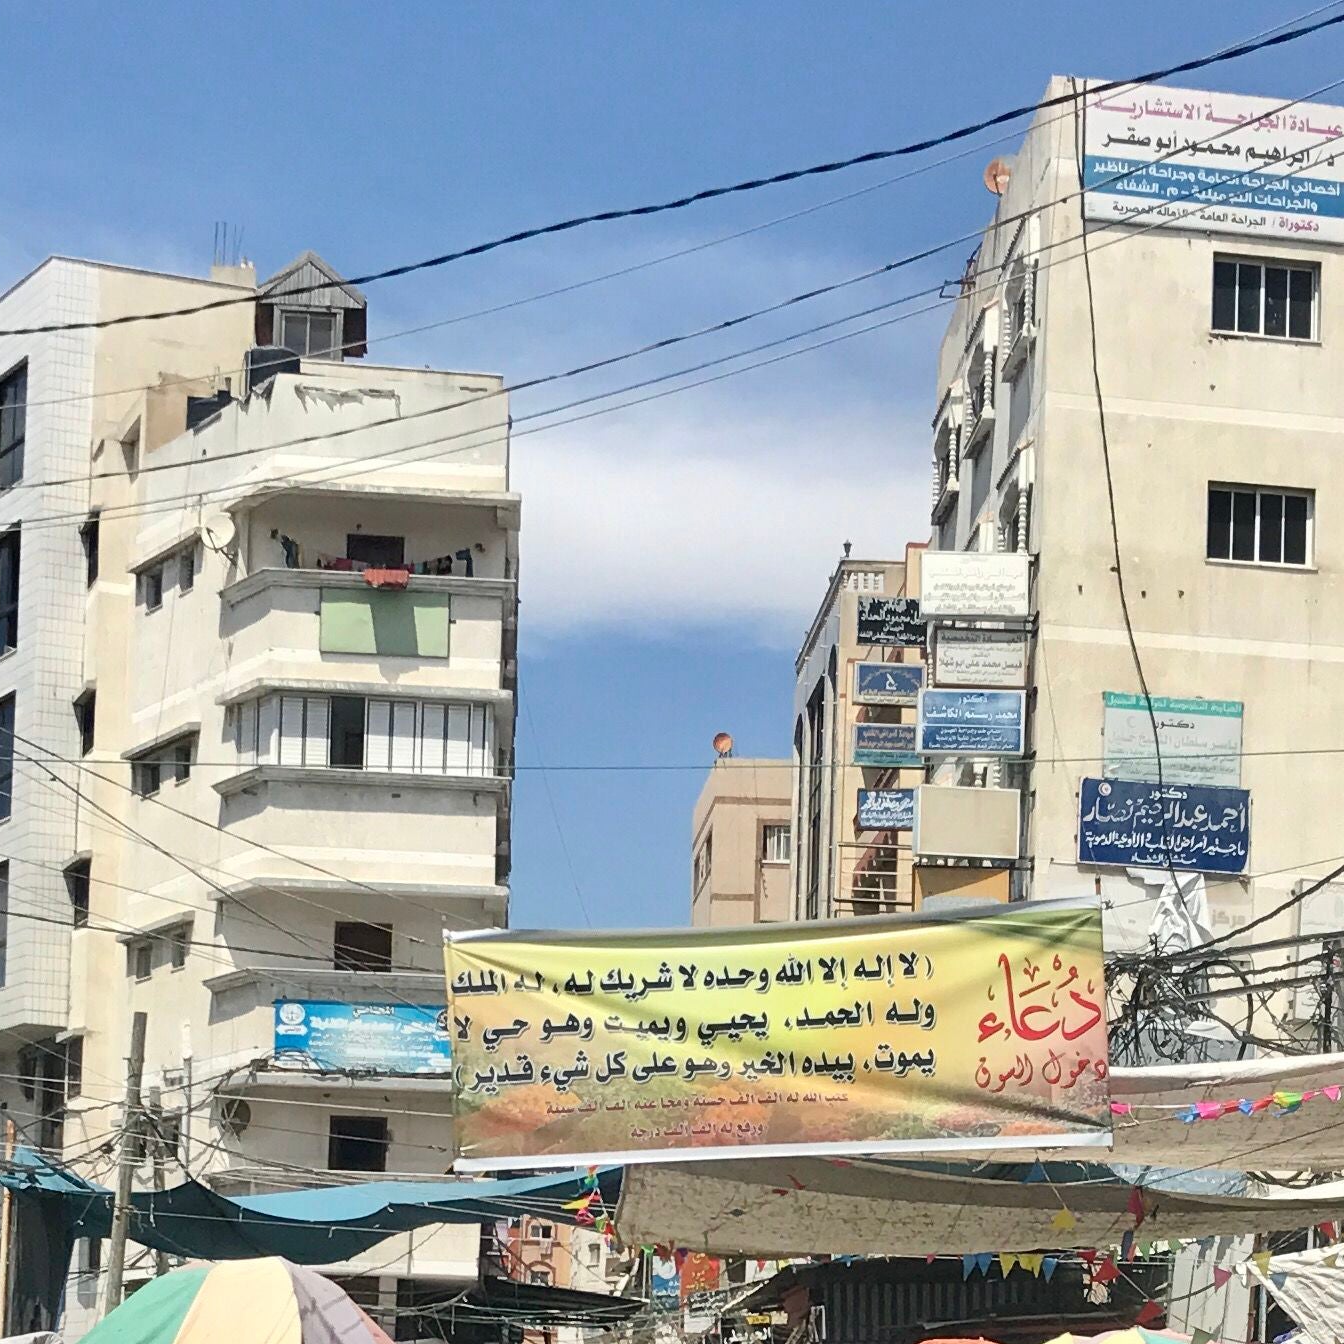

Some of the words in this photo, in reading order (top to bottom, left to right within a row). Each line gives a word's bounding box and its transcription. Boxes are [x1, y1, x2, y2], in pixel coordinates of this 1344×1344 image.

[1203, 103, 1288, 133] الجراحة
[1289, 114, 1344, 141] عيادة
[1101, 126, 1152, 148] صقر
[1183, 136, 1241, 157] محمود
[1148, 164, 1196, 183] وجراحة
[1197, 168, 1240, 186] العامة
[1240, 175, 1290, 191] الجراحة
[1115, 178, 1160, 194] الشفاء
[1199, 207, 1229, 222] العامة
[1253, 194, 1318, 212] والجراحات
[1231, 211, 1266, 229] الجراحة
[1278, 216, 1320, 232] دكتوراة
[925, 705, 962, 718] الكاشف
[996, 711, 1018, 720] محمد
[1148, 786, 1189, 801] دكتور
[1199, 802, 1246, 834] أحمد
[1203, 837, 1246, 857] ماجستير
[677, 963, 699, 989] لا
[702, 964, 770, 993] وحده
[775, 952, 814, 985] الله
[817, 955, 849, 989] إلا
[853, 953, 894, 988] إله
[451, 968, 507, 995] الملك
[513, 970, 546, 993] له
[599, 961, 674, 1003] شريك
[885, 997, 937, 1030] وله
[453, 1014, 472, 1041] لا
[482, 1017, 530, 1053] حي
[539, 1012, 595, 1043] وهو
[696, 1010, 769, 1050] يحيي
[539, 1050, 590, 1093] شيء
[594, 1050, 628, 1084] كل
[631, 1051, 679, 1083] على
[682, 1054, 732, 1082] وهو
[737, 1050, 797, 1082] الخير
[801, 1050, 858, 1084] بيده
[974, 1052, 1034, 1094] السوق
[1041, 1048, 1108, 1090] دخول
[633, 1098, 657, 1111] عنه
[660, 1096, 690, 1111] ومحا
[692, 1095, 725, 1109] حسنة
[785, 1092, 800, 1104] له
[802, 1091, 823, 1103] الله
[824, 1092, 850, 1103] كتب
[630, 1125, 660, 1141] درجة
[720, 1123, 734, 1136] له
[736, 1122, 765, 1138] ورفع
